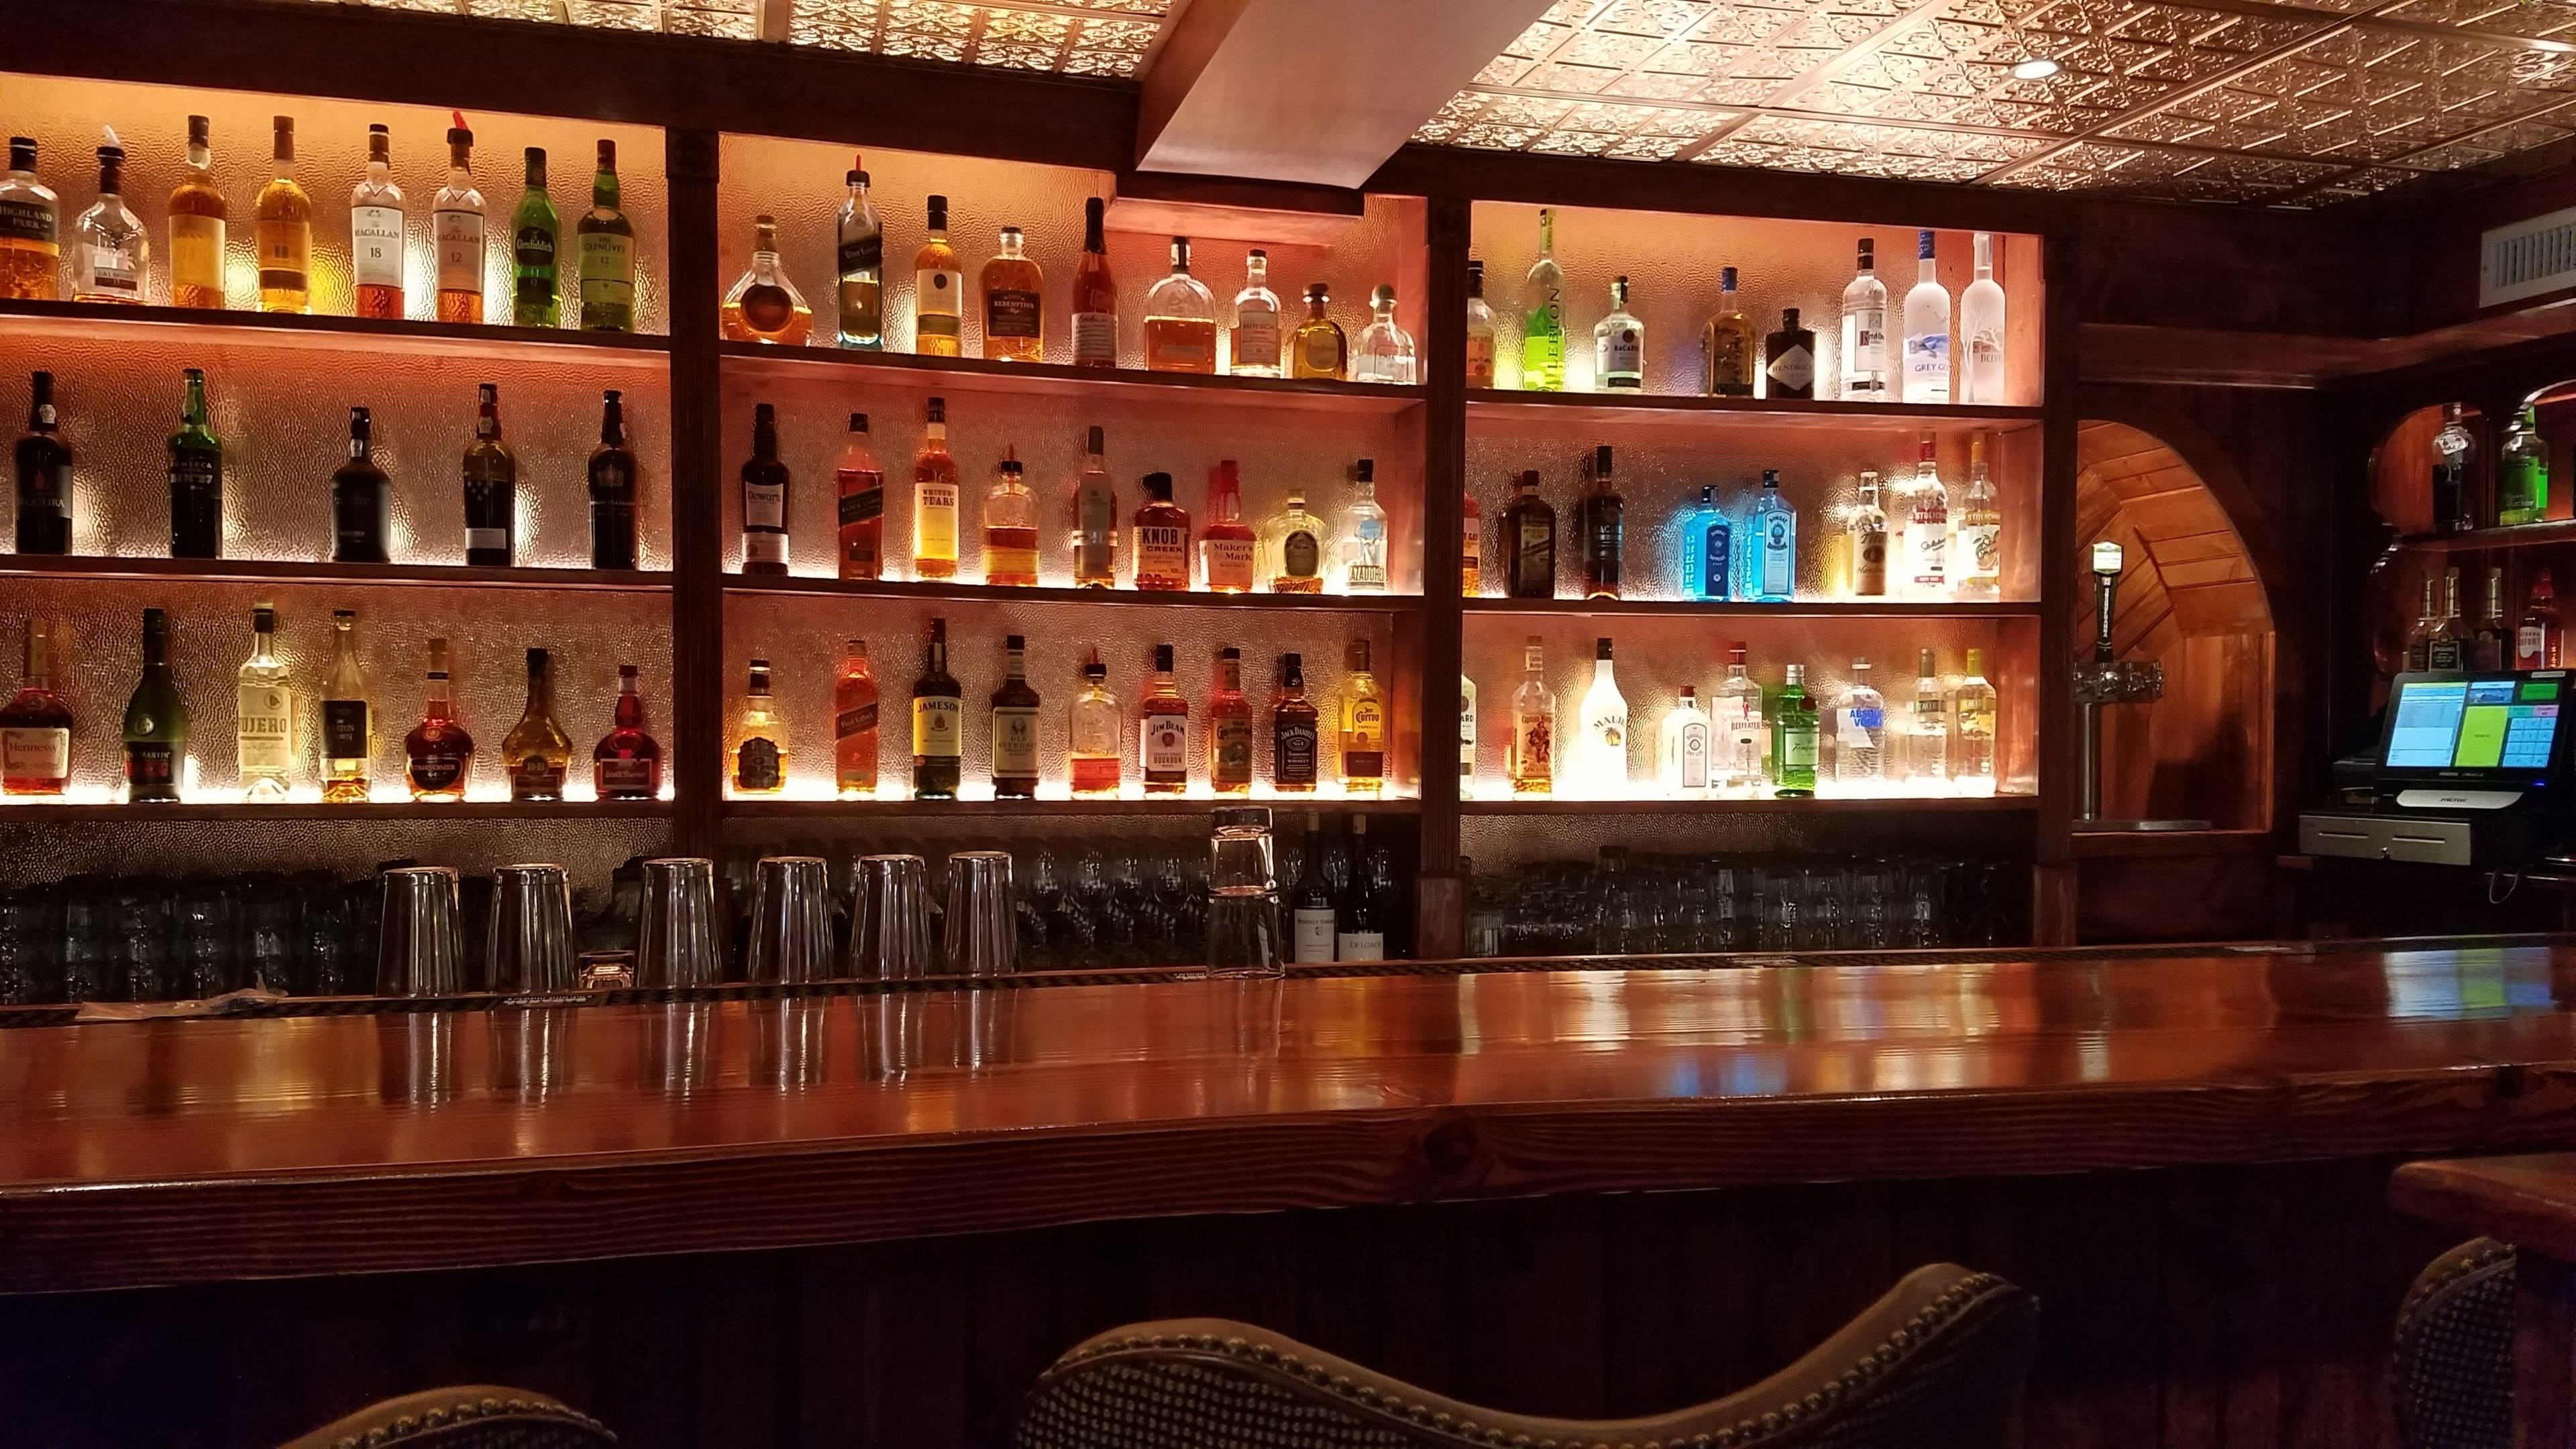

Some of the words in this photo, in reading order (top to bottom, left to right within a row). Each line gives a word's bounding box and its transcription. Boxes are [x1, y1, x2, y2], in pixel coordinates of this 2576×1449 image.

[13, 218, 39, 229] PARK
[355, 229, 399, 239] MACALLAN
[437, 233, 480, 244] MACALLAN
[517, 239, 553, 252] Glenfiddich
[584, 243, 626, 254] GLENLIVET
[370, 247, 382, 258] 18
[451, 252, 462, 263] 12
[600, 256, 610, 264] 12
[994, 300, 1034, 309] REDEMPTION
[1242, 323, 1275, 331] HIRSCH
[1547, 287, 1560, 370] LEBLON
[1915, 364, 1937, 372] GREY
[170, 460, 213, 469] FONSECA
[922, 496, 955, 506] TEARS
[1768, 515, 1788, 525] BOMBAY
[1142, 527, 1178, 545] KNOB
[1711, 529, 1726, 537] BOMBAY
[1146, 545, 1183, 553] CREEK
[1225, 552, 1252, 561] Mark
[1349, 566, 1385, 582] AZADORE
[917, 701, 959, 714] JAMESON
[841, 717, 856, 729] Red
[855, 712, 873, 723] Label
[1356, 710, 1380, 723] Cuervo
[1593, 715, 1625, 729] MALI
[239, 717, 287, 734] UJERO
[1150, 723, 1165, 736] JIM
[1165, 720, 1185, 736] BEAM
[1731, 721, 1761, 731] BEEFEATER
[1281, 729, 1295, 741] JACK
[9, 742, 58, 755] Hennessy
[1154, 756, 1182, 764] BOURBON
